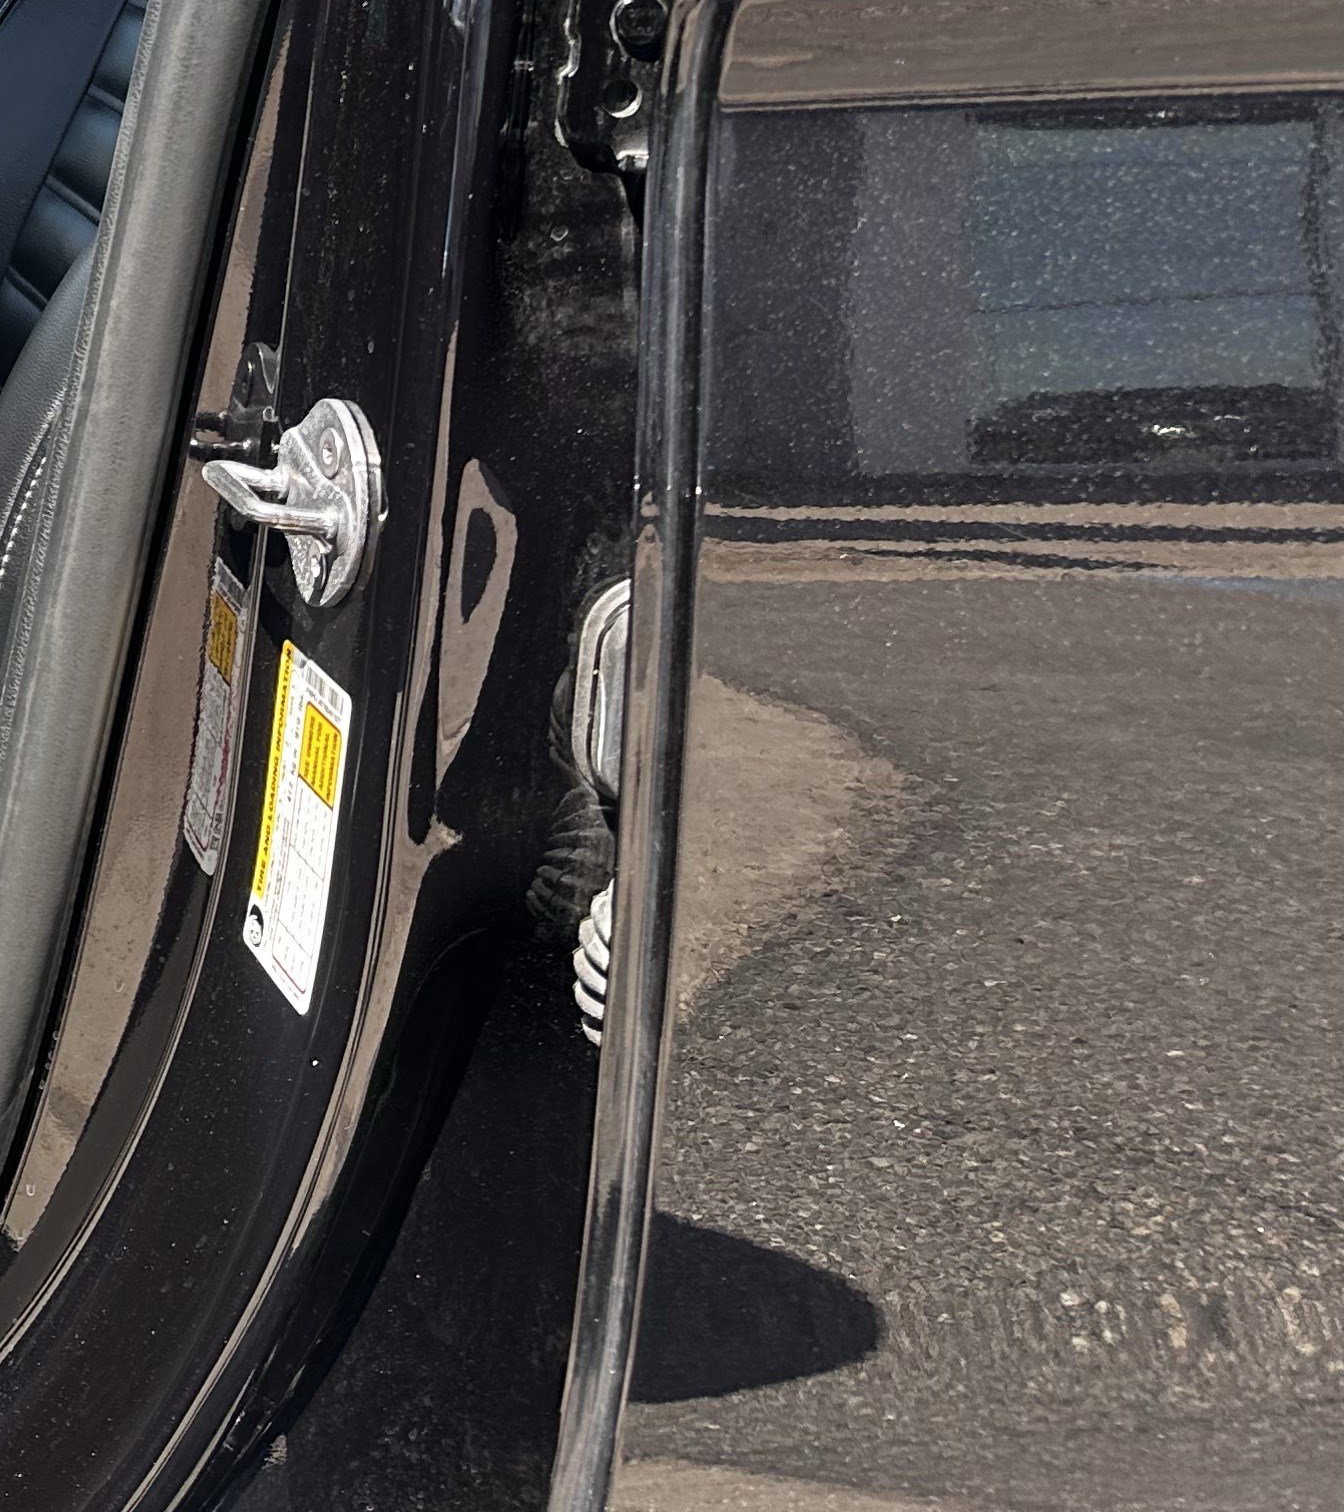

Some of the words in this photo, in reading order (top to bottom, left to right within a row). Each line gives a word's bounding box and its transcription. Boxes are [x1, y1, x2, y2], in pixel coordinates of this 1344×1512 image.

[256, 860, 266, 892] TIRE
[263, 824, 271, 856] AND
[267, 755, 280, 822] LOADING
[275, 647, 292, 753] INFORMATION
